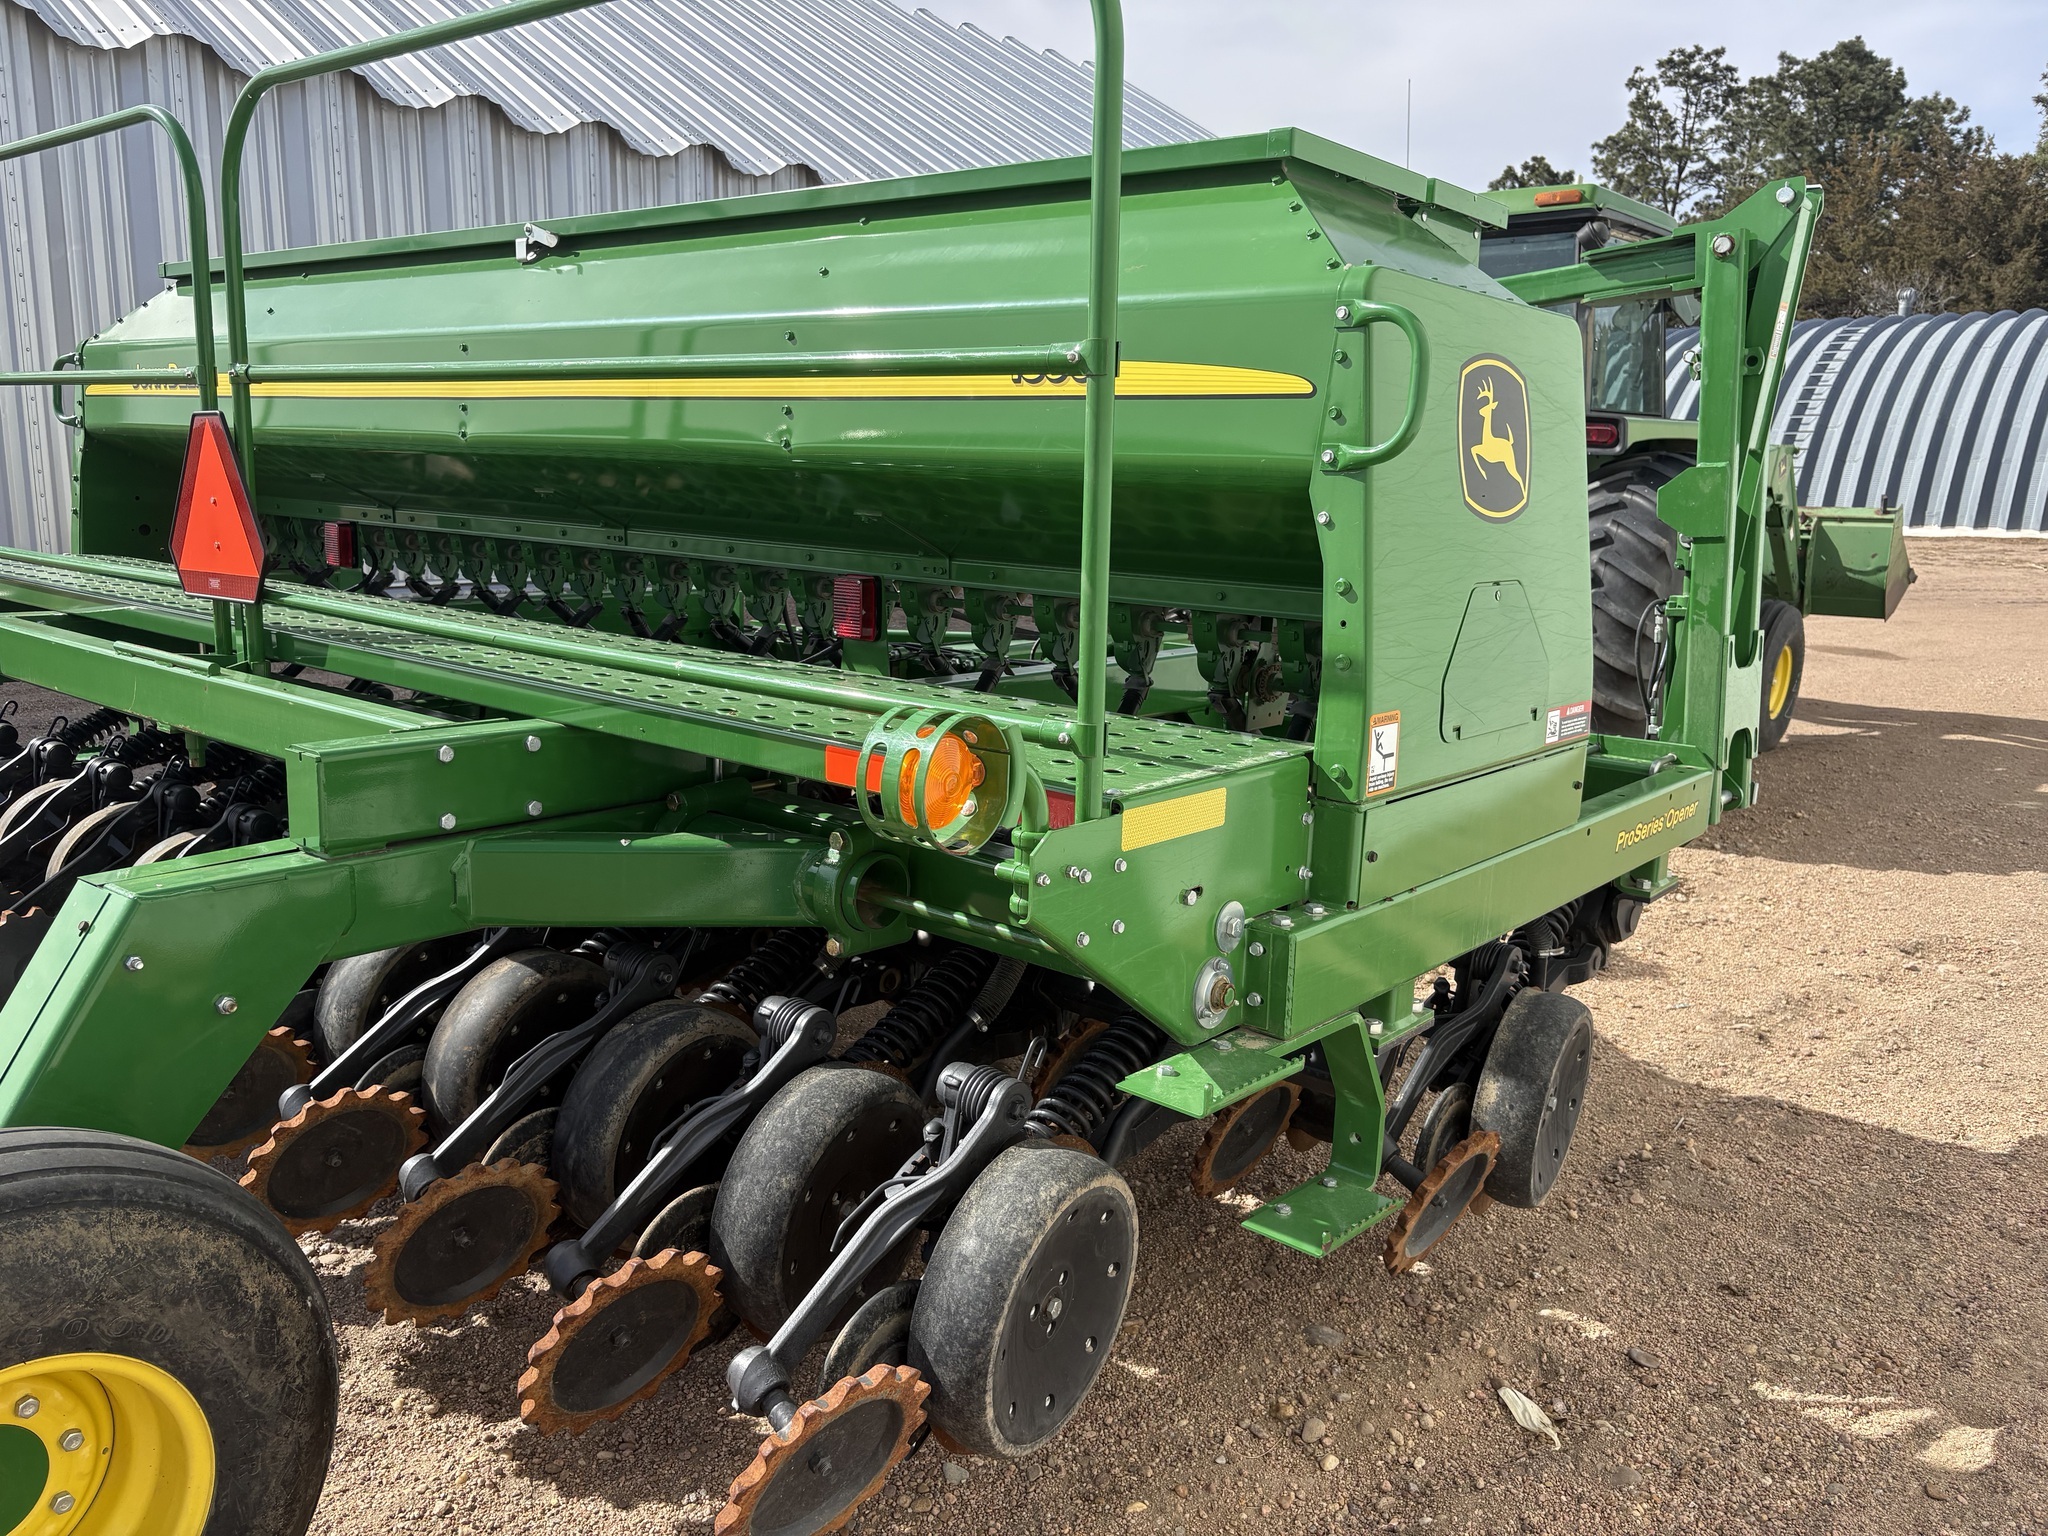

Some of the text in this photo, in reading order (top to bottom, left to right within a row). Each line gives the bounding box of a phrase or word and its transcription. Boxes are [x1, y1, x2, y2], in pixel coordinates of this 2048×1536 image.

[1377, 713, 1399, 724] WARNING
[1615, 801, 1700, 854] ProSeries Opener
